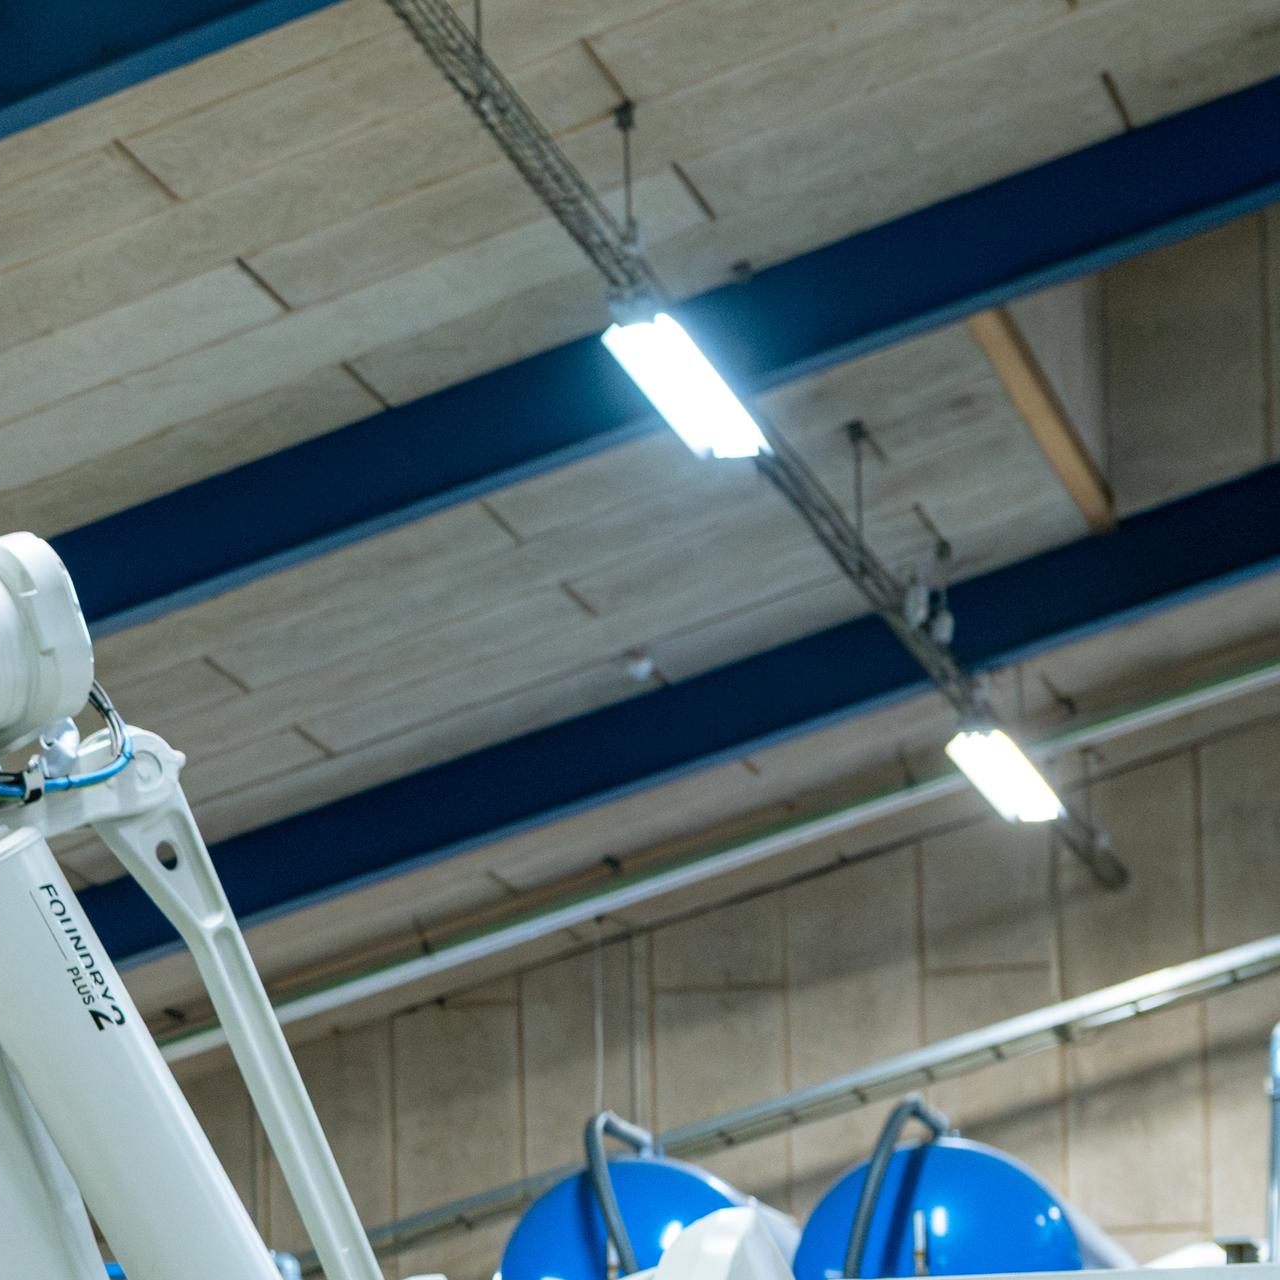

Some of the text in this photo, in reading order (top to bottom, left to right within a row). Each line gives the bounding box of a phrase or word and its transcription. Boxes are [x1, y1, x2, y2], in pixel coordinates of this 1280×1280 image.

[39, 883, 115, 1001] FOUNDRY
[66, 966, 126, 1031] PLUS 2
